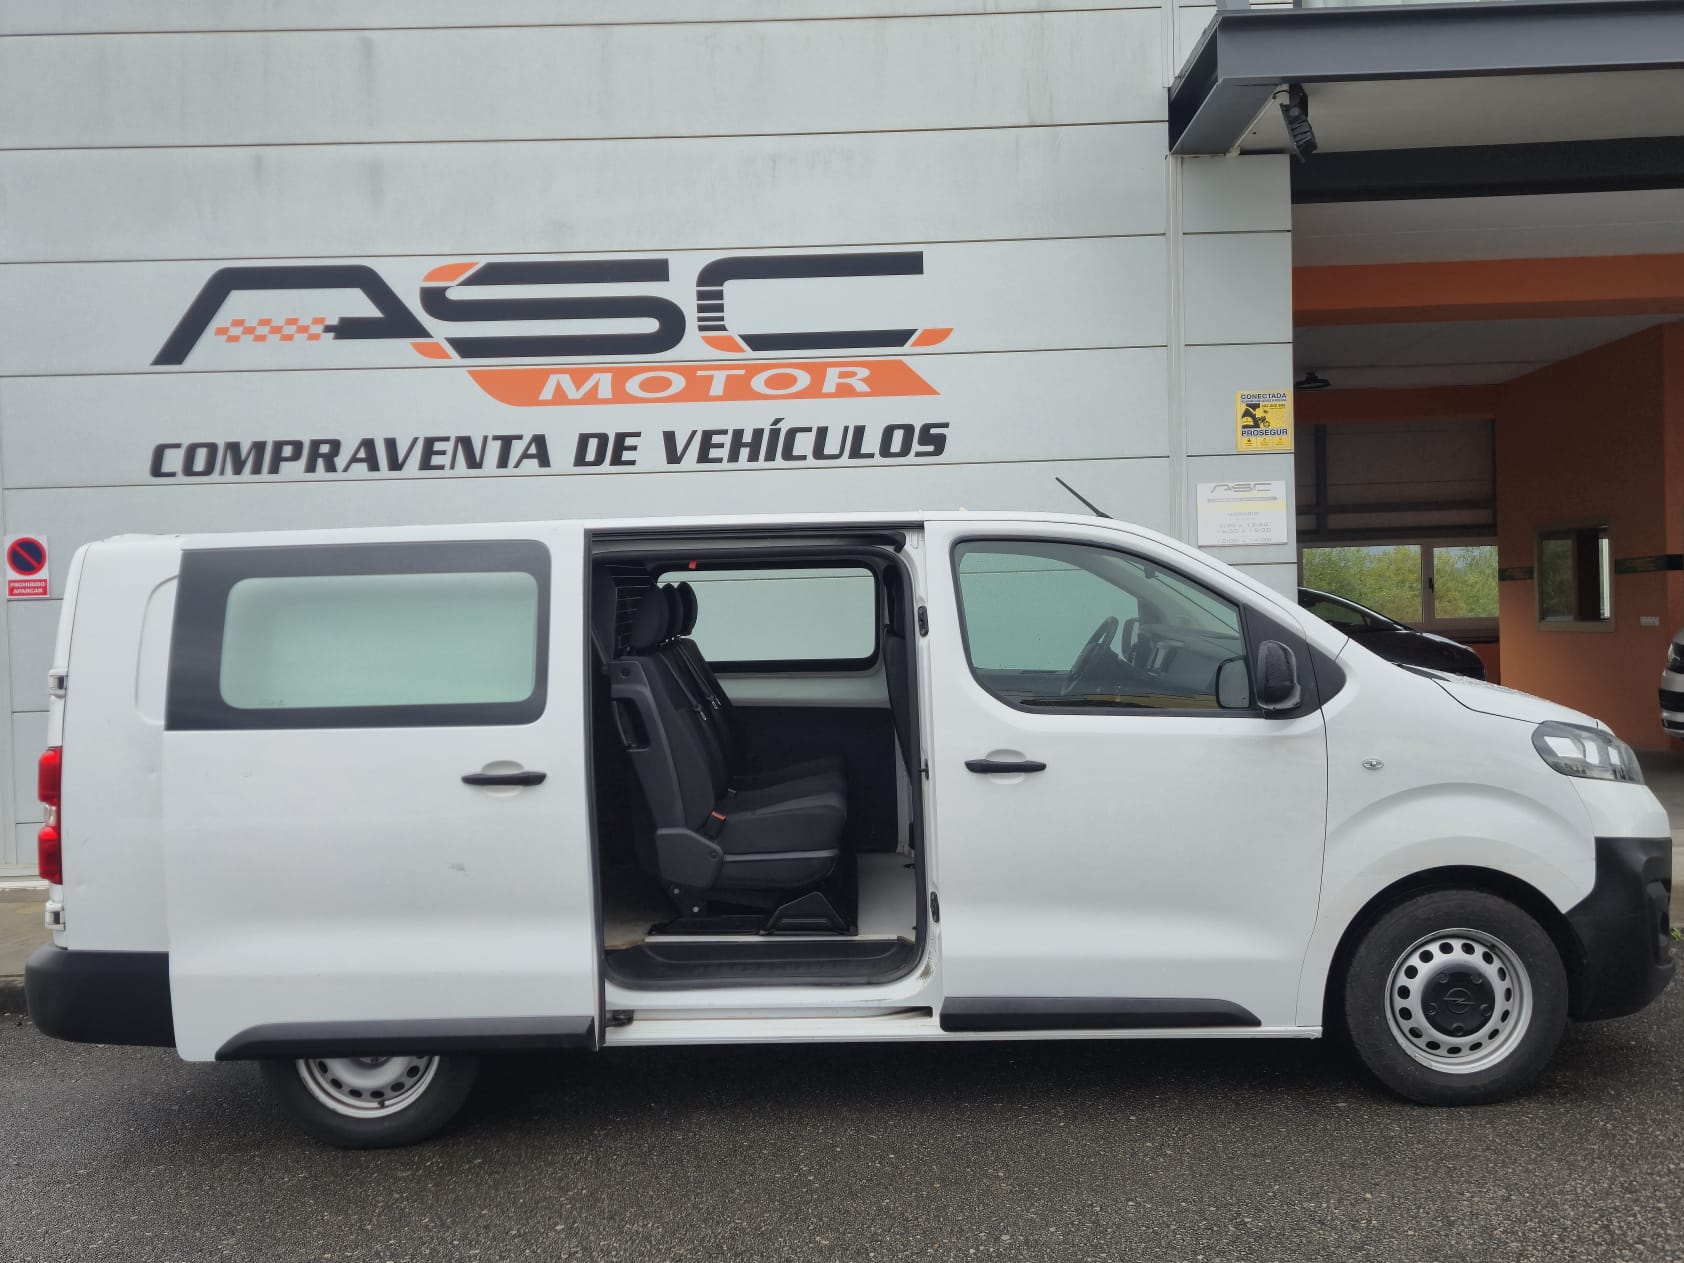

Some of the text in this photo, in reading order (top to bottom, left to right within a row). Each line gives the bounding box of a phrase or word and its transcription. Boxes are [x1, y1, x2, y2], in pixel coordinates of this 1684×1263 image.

[150, 251, 953, 365] ASC
[537, 367, 872, 401] MOTOR
[150, 417, 950, 478] COMPRAVENTA DE VEHÍCULOS
